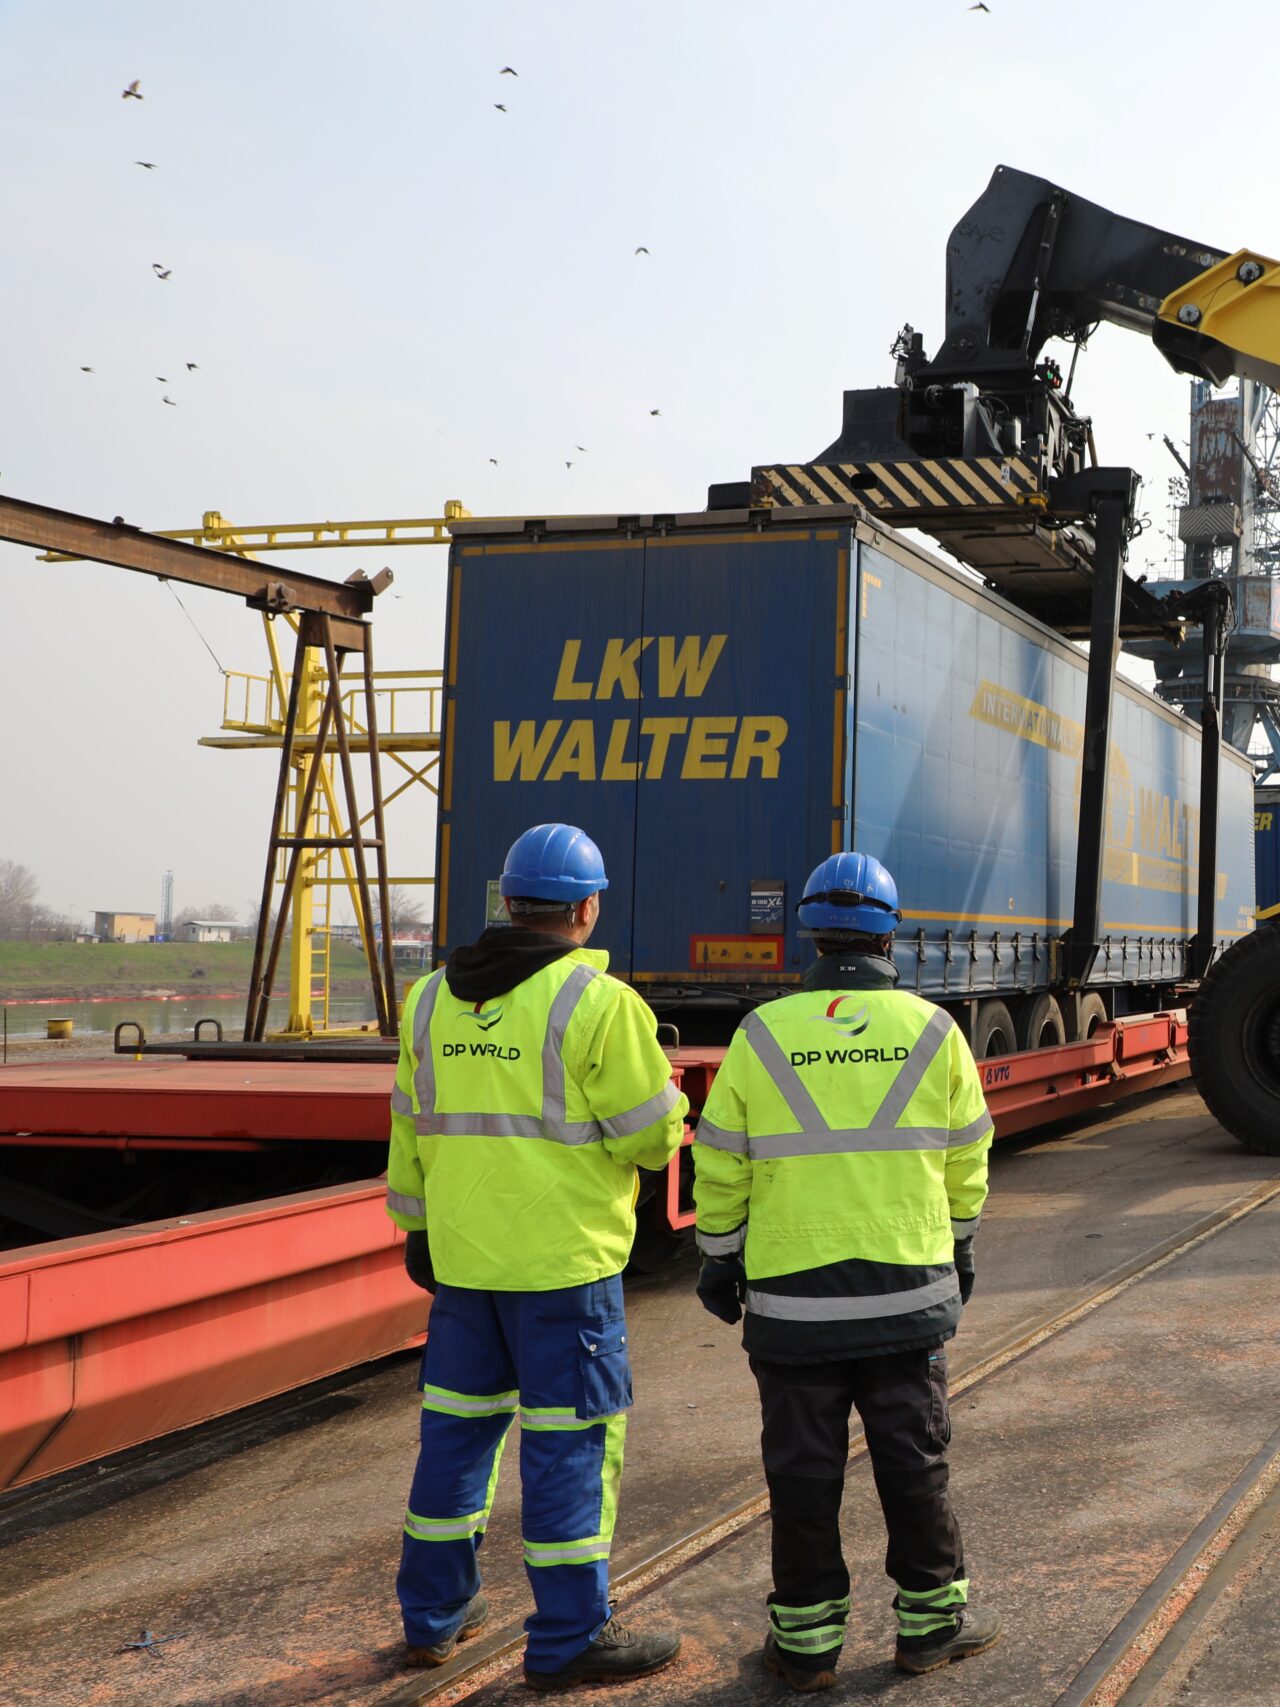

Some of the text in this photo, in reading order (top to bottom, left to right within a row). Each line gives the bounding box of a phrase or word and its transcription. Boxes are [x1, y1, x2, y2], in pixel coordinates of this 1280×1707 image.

[552, 634, 728, 701] LKW
[493, 715, 789, 782] WALTER
[1139, 784, 1200, 866] WALT
[442, 1043, 521, 1061] DP WRLD
[790, 1047, 909, 1066] DP WORLD
